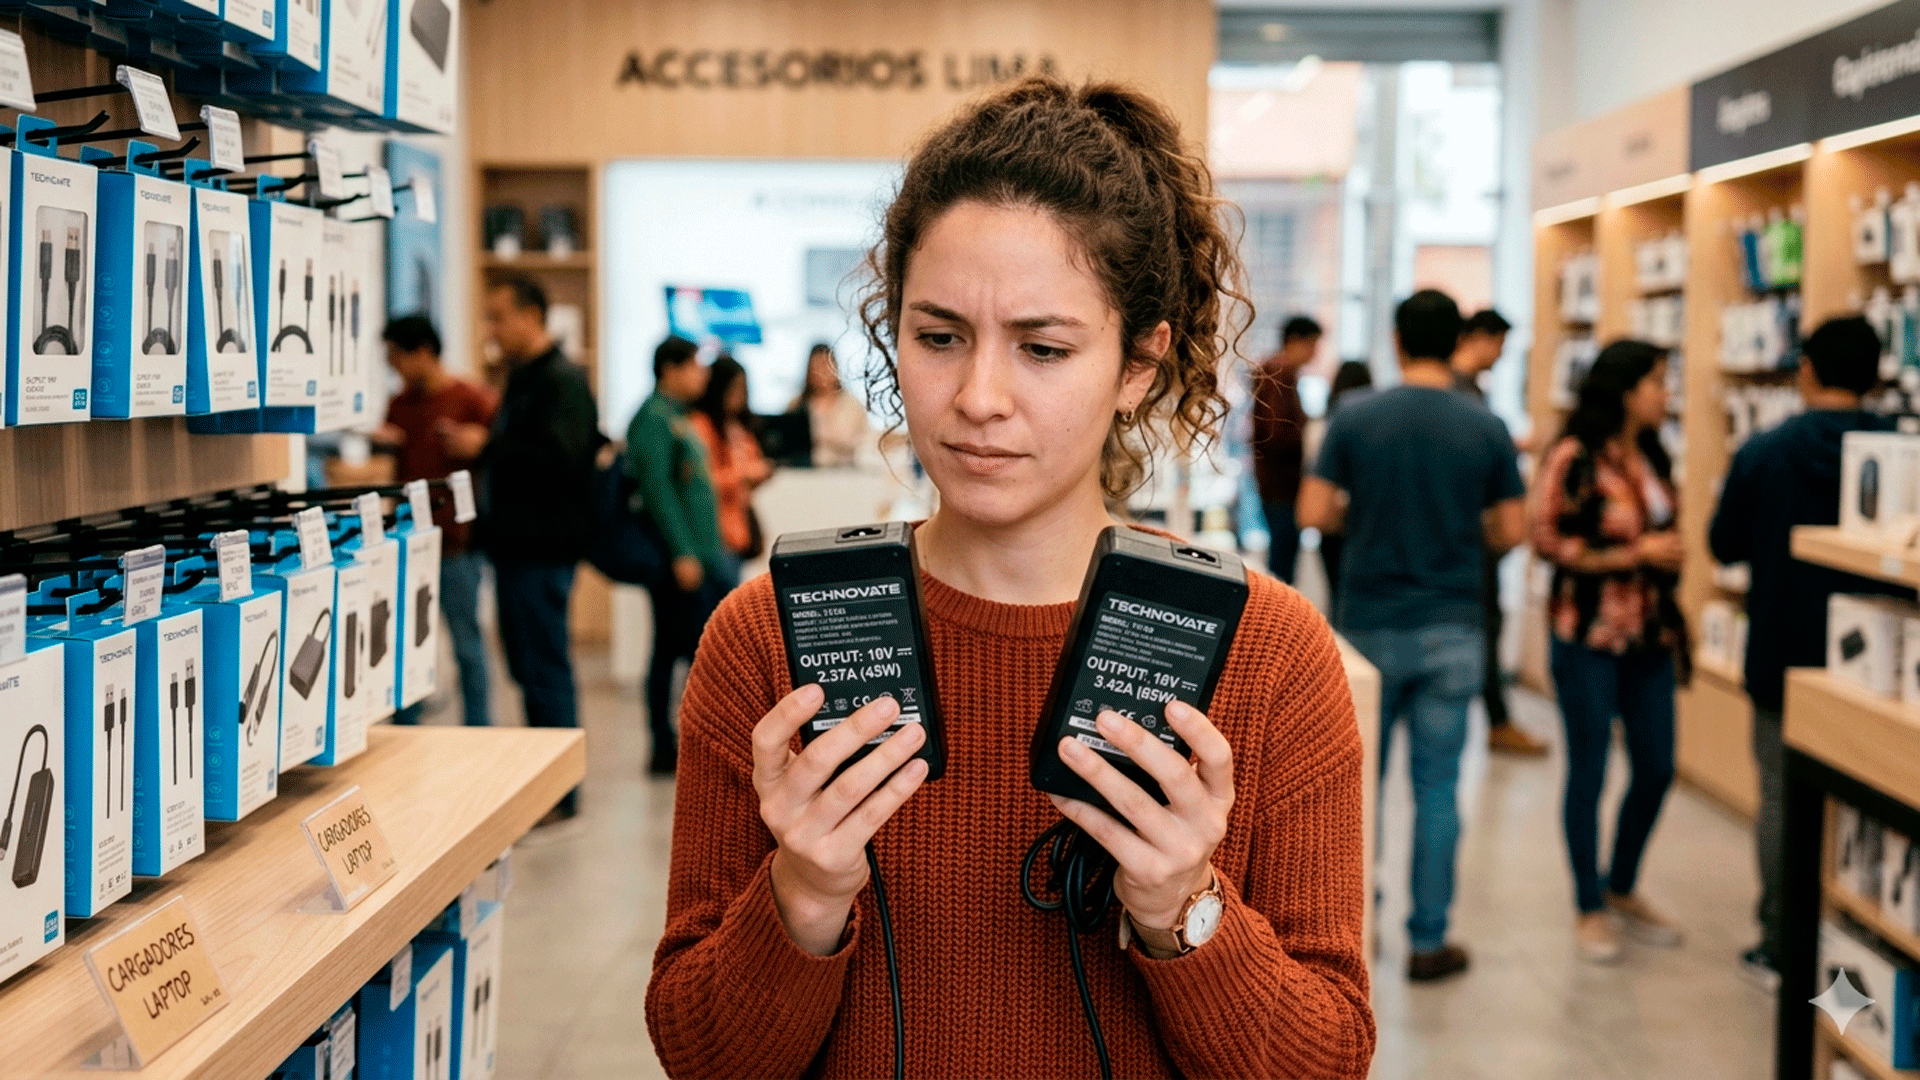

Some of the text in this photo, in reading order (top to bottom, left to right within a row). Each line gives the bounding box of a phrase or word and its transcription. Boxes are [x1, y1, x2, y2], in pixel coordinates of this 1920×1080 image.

[617, 48, 927, 91] ACCESORIOS
[790, 583, 900, 604] TECHNOVATE
[1109, 598, 1217, 634] TECHNOVATE
[800, 649, 863, 668] OUTPUT:
[817, 667, 858, 683] 2.37A
[1094, 674, 1133, 696] 3.42A
[108, 922, 195, 992] CARGADORES
[143, 969, 191, 1019] LAPTOP
